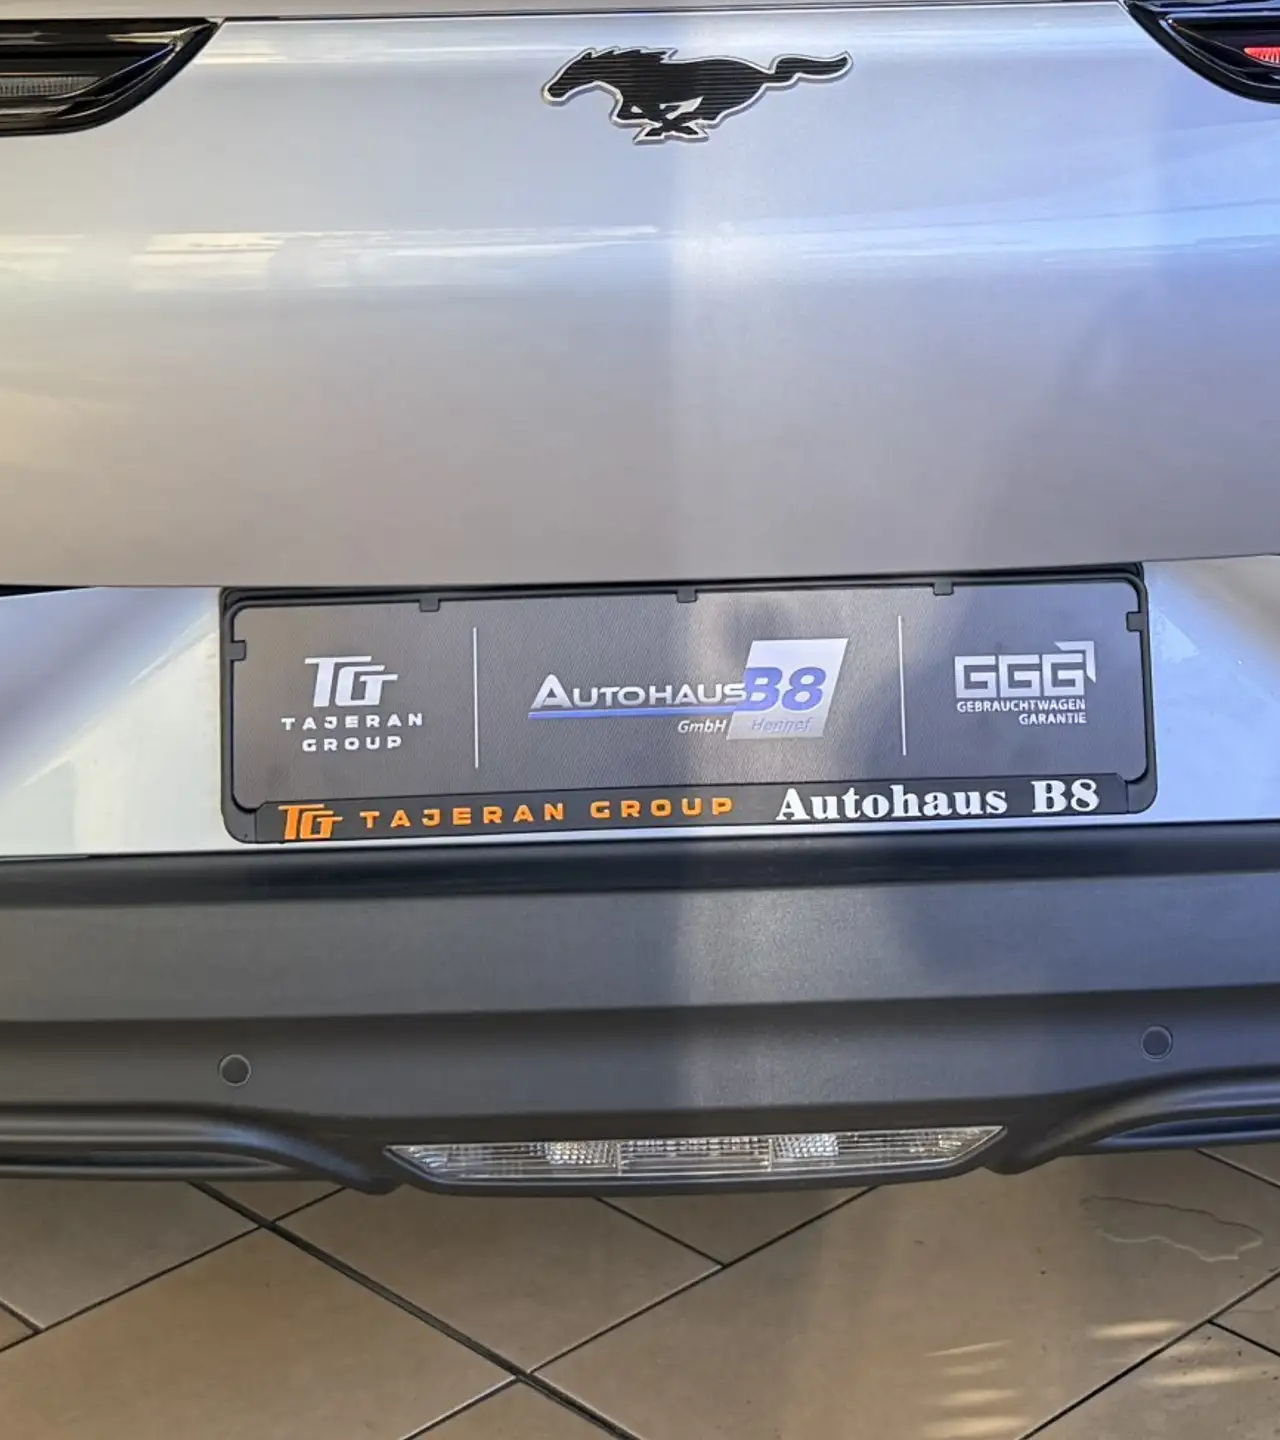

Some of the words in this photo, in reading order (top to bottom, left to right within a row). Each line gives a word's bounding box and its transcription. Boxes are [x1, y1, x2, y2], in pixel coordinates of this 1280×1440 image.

[304, 655, 399, 707] TG
[955, 652, 1086, 699] GGG
[956, 697, 1086, 713] GEBRAUCHTWAGEN
[281, 712, 423, 731] TAJERAN
[677, 718, 728, 734] GmbH
[1018, 711, 1088, 726] GARANTIE
[301, 735, 403, 753] GROUP
[278, 803, 343, 841] TG
[360, 802, 565, 828] TAJERAN
[590, 796, 735, 820] GROUP
[775, 784, 1009, 822] Autohaus
[1030, 778, 1101, 813] B8
